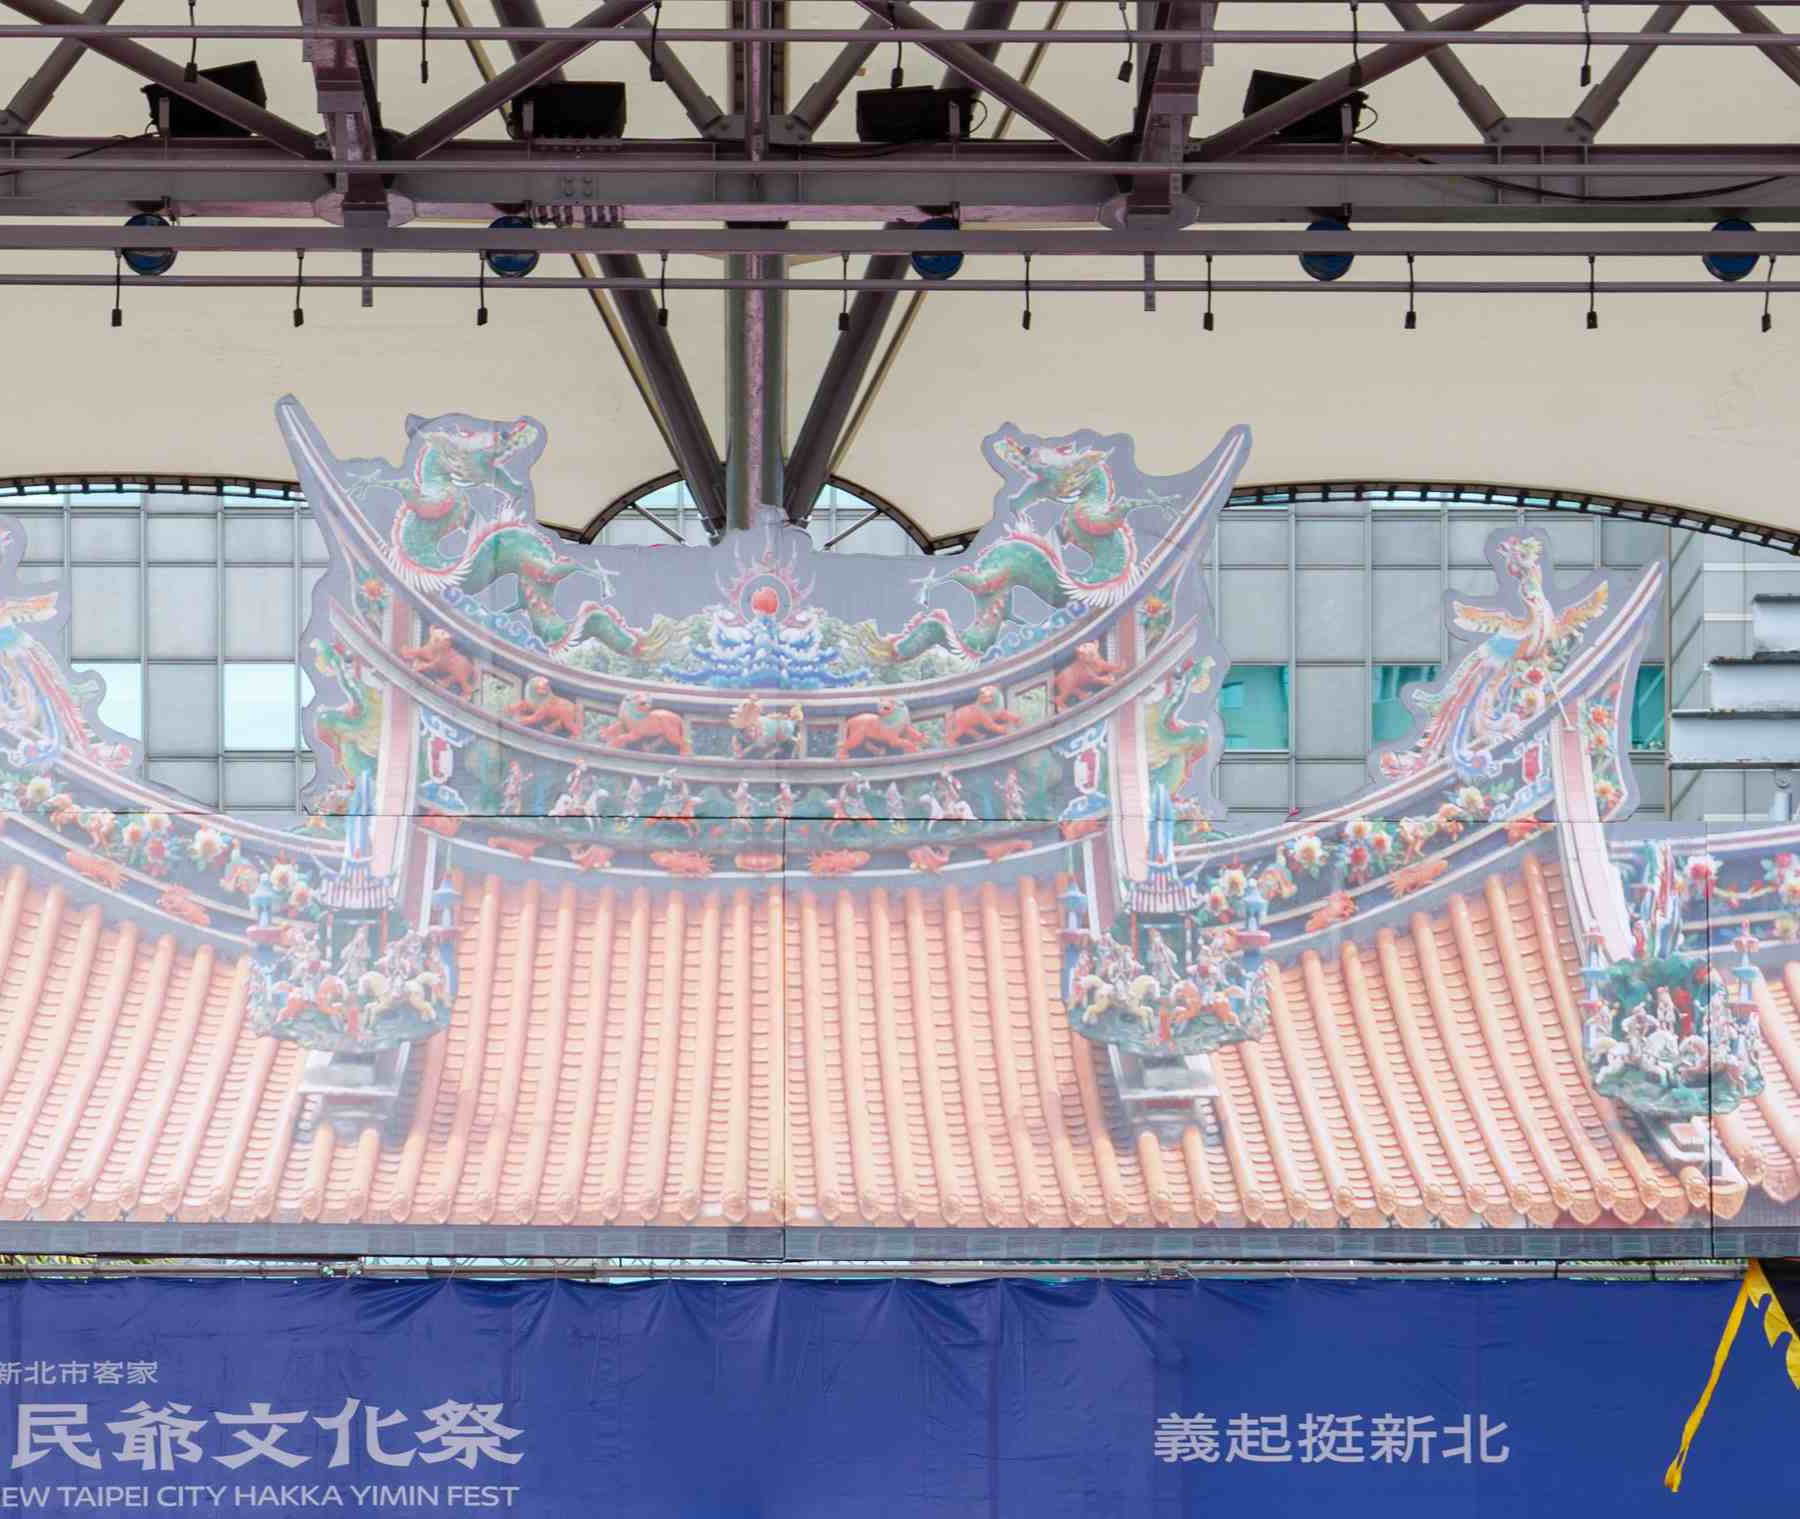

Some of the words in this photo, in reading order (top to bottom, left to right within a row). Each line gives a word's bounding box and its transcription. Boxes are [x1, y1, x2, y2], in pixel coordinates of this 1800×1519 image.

[1153, 1413, 1510, 1464] 義起挺新北
[56, 1486, 149, 1507] TAIPEI
[156, 1485, 228, 1507] CITY
[234, 1485, 344, 1507] HAKKA
[350, 1485, 439, 1506] YIMIN
[447, 1485, 520, 1507] FEST
